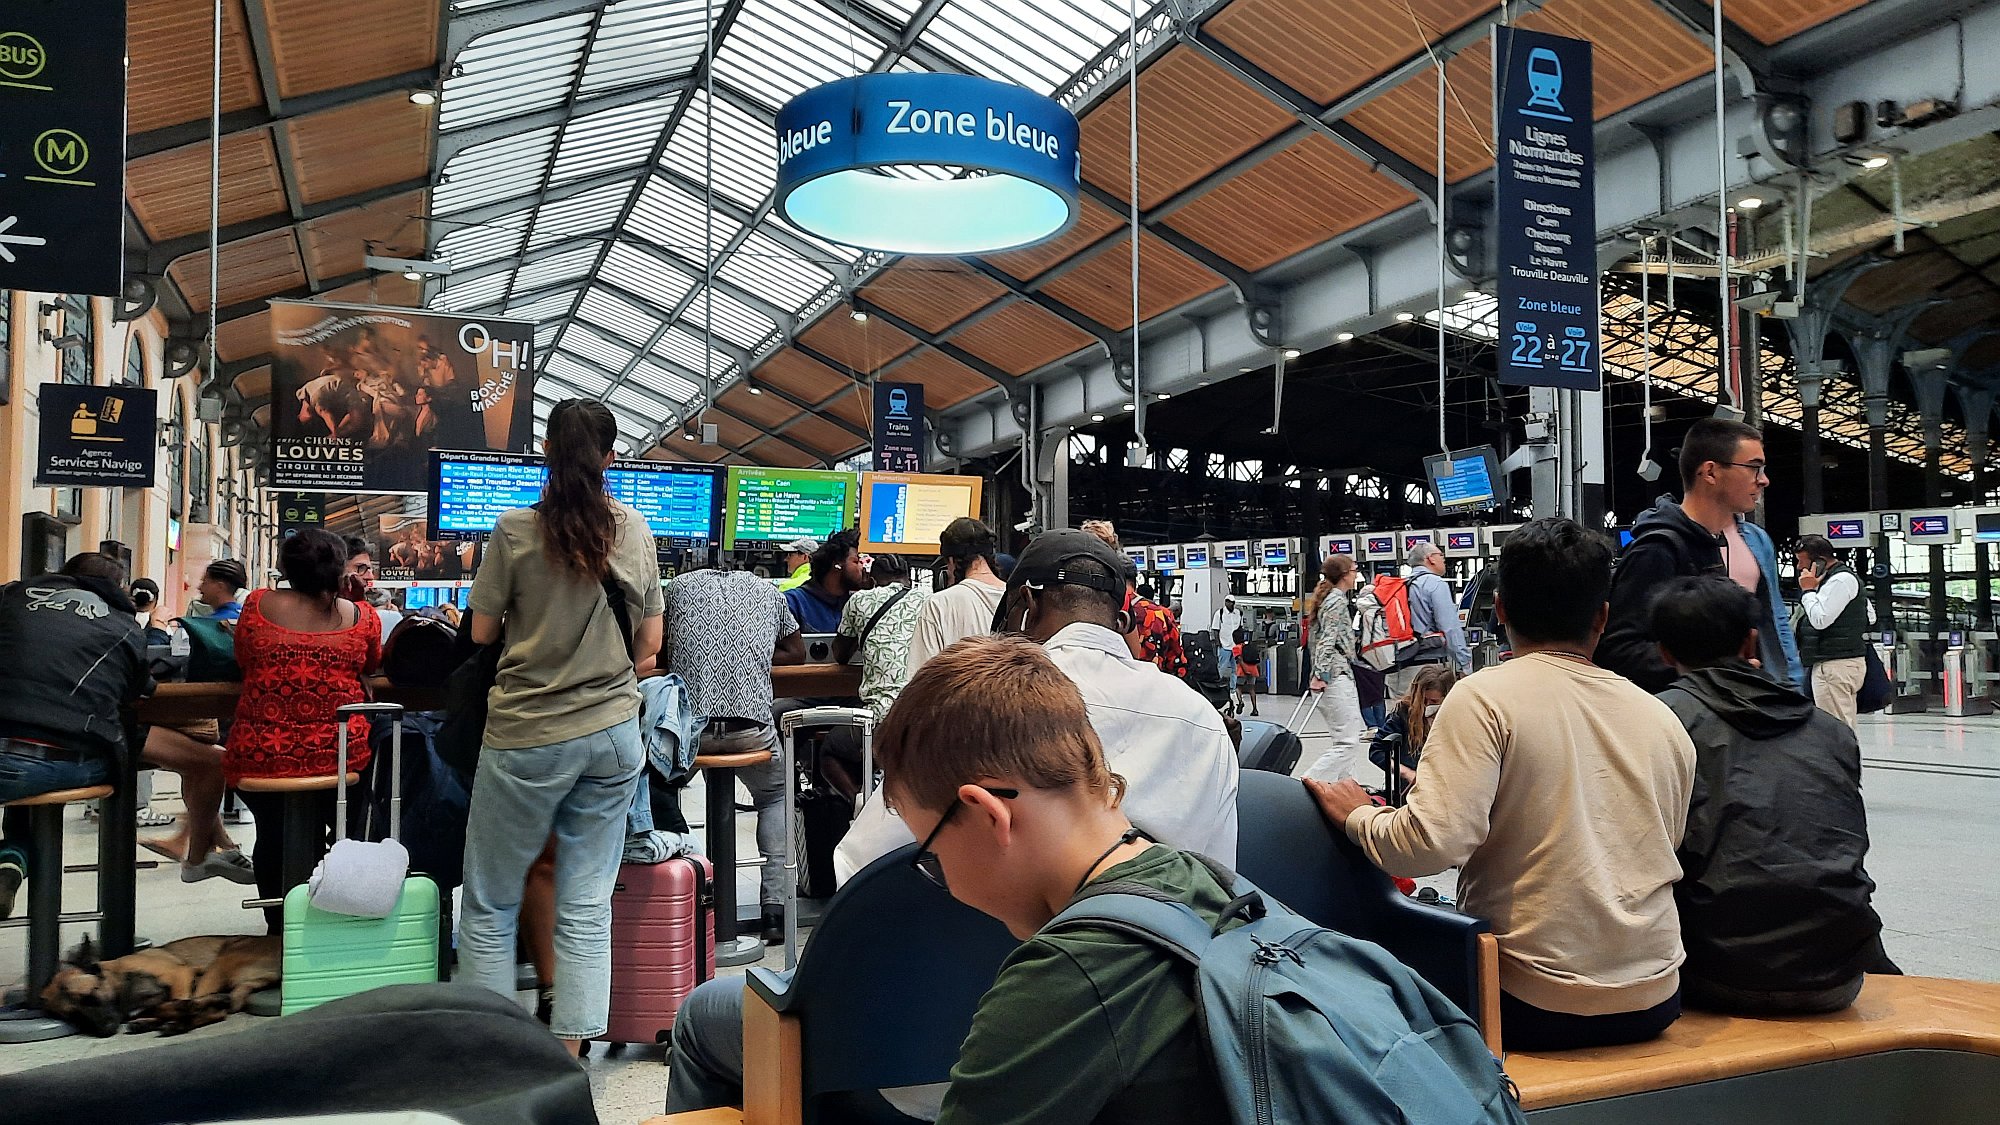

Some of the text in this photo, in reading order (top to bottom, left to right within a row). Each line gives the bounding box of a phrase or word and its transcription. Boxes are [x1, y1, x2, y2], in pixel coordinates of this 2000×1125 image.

[0, 44, 39, 66] BUS
[887, 101, 1059, 159] Zone bleue
[1525, 125, 1568, 147] Lignes
[48, 138, 76, 165] M
[780, 120, 832, 166] bleue
[1508, 139, 1584, 166] Normandes
[1524, 199, 1572, 216] Directions
[1536, 214, 1560, 228] Caen
[1524, 226, 1572, 245] Cherbourg
[1534, 241, 1563, 254] Rouen
[1528, 254, 1568, 268] Le Havre
[1510, 265, 1588, 284] Trouville Deauville
[1518, 297, 1581, 314] Zone bleue
[458, 323, 529, 370] OH!
[1512, 334, 1590, 366] 22 à 27
[470, 379, 497, 400] BON
[472, 371, 514, 412] MARCHÉ
[889, 422, 909, 431] Trains
[304, 436, 351, 446] CHIENS
[81, 448, 112, 458] Agence
[276, 445, 364, 460] LOUVES
[50, 456, 142, 472] Services Navigo
[883, 459, 890, 470] 1
[904, 460, 918, 471] 11
